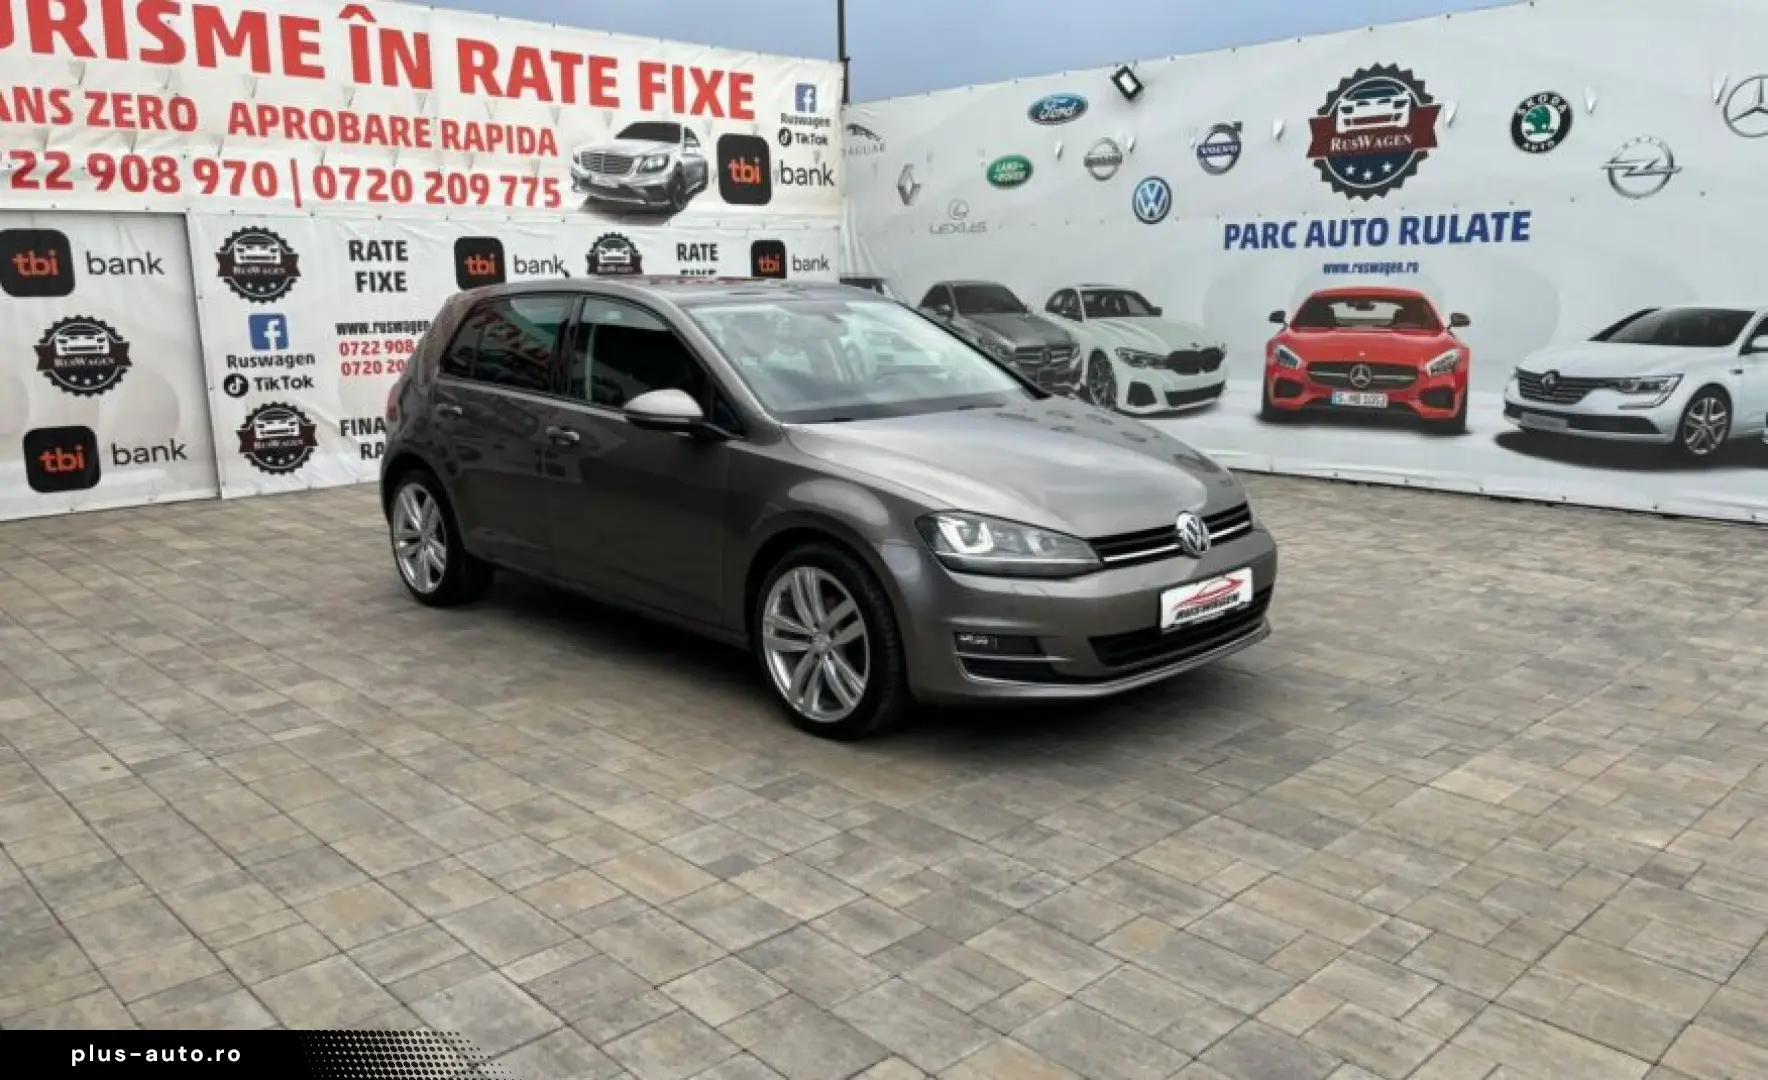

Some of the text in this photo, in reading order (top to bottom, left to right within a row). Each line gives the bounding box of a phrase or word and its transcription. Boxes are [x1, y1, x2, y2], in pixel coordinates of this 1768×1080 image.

[338, 4, 433, 91] ÎN
[456, 38, 620, 109] RATE
[639, 60, 755, 120] FIXE
[84, 91, 198, 132] ZERO
[228, 102, 433, 148] APROBARE
[441, 118, 558, 158] RAPIDA
[795, 132, 829, 146] TikTok
[1200, 145, 1239, 155] VOLVO
[0, 150, 74, 190] 22
[85, 153, 181, 194] 908
[192, 159, 278, 197] 970
[312, 164, 412, 203] 0720
[425, 171, 490, 205] 209
[500, 175, 562, 208] 775
[728, 158, 834, 186] tbi bank
[1224, 210, 1532, 250] PARC AUTO RULATE
[349, 239, 409, 262] RATE
[676, 241, 719, 262] RATE
[12, 250, 164, 276] tbi bank
[464, 253, 564, 276] tbi bank
[757, 254, 831, 275] tbi bank
[1323, 261, 1420, 277] www.ruswagen.ro
[355, 271, 408, 293] FIXE
[335, 320, 430, 335] www.ruswagen
[339, 338, 416, 356] 0722 908
[226, 353, 316, 370] Ruswagen
[340, 358, 406, 376] 0720 20
[253, 373, 316, 393] TikTok
[339, 416, 387, 437] FINA
[39, 438, 188, 474] tbi bank
[360, 441, 386, 460] RA
